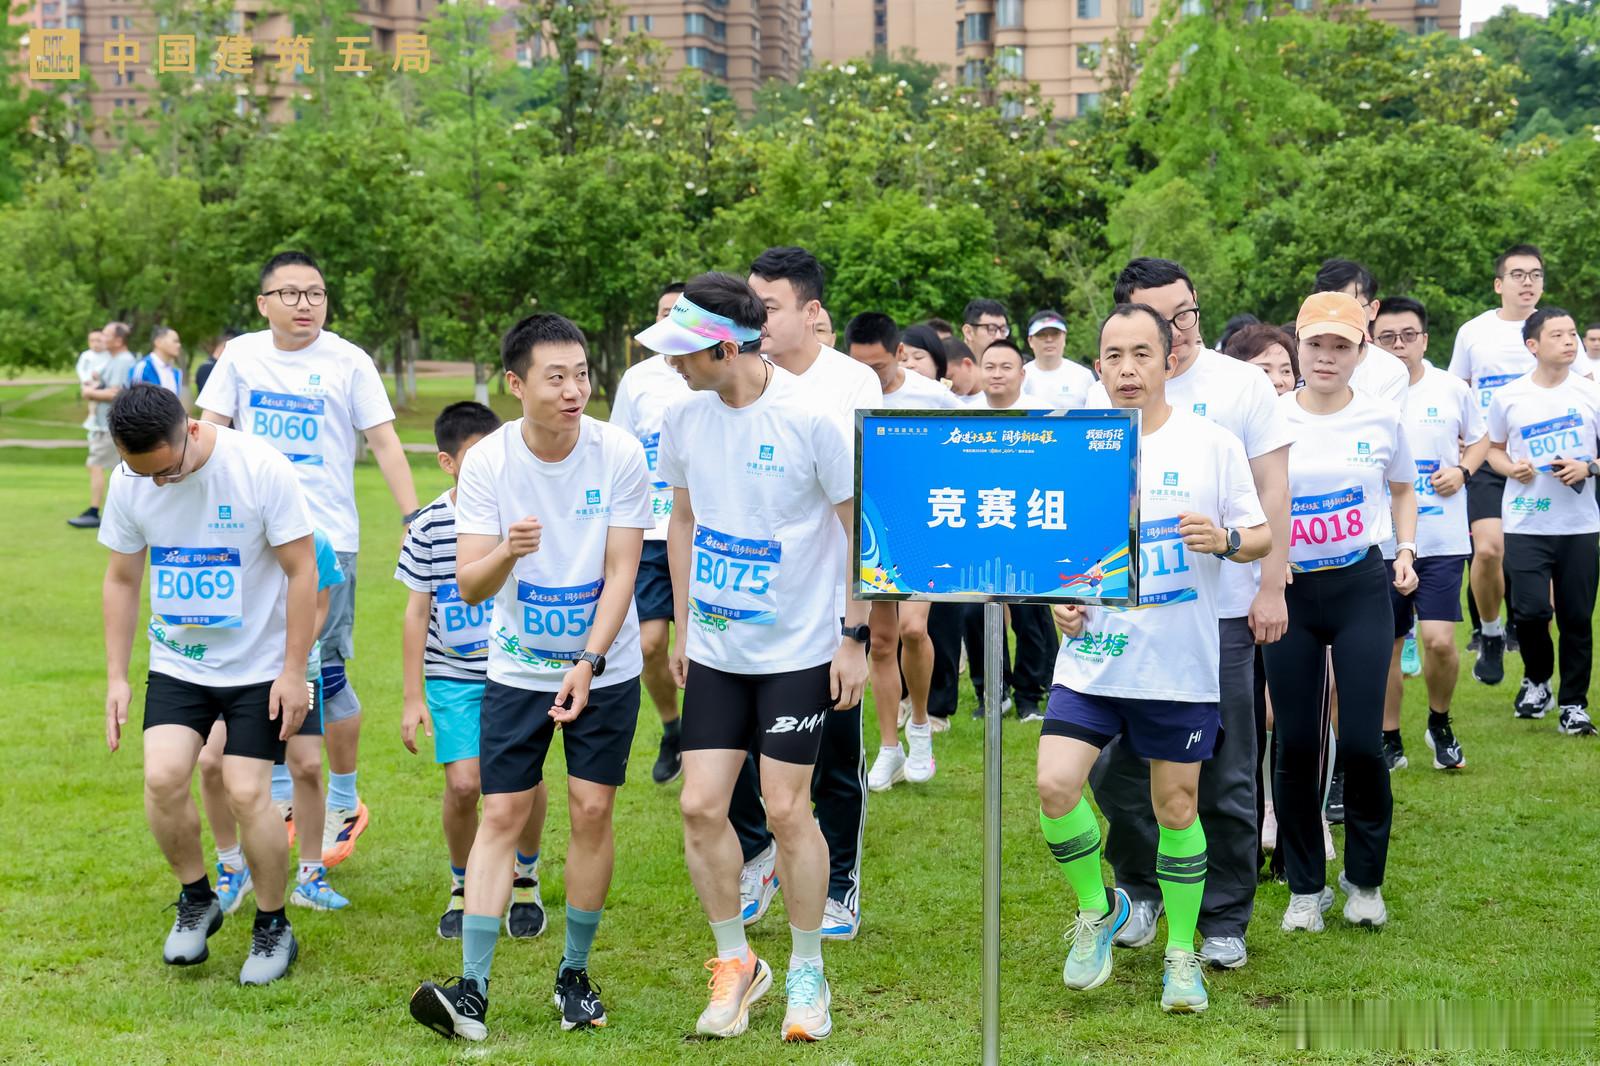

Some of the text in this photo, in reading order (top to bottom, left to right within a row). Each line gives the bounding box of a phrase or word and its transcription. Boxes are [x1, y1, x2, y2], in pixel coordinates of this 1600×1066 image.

[252, 409, 318, 441] B060
[1085, 428, 1125, 441] 我爱雨花
[1087, 440, 1122, 452] 我爱五局
[1528, 430, 1583, 457] B071
[1414, 475, 1437, 496] 49
[926, 486, 1068, 530] 竞赛组
[1290, 508, 1364, 547] A018
[696, 551, 771, 595] B075
[1140, 542, 1189, 578] 011
[157, 569, 235, 600] B069
